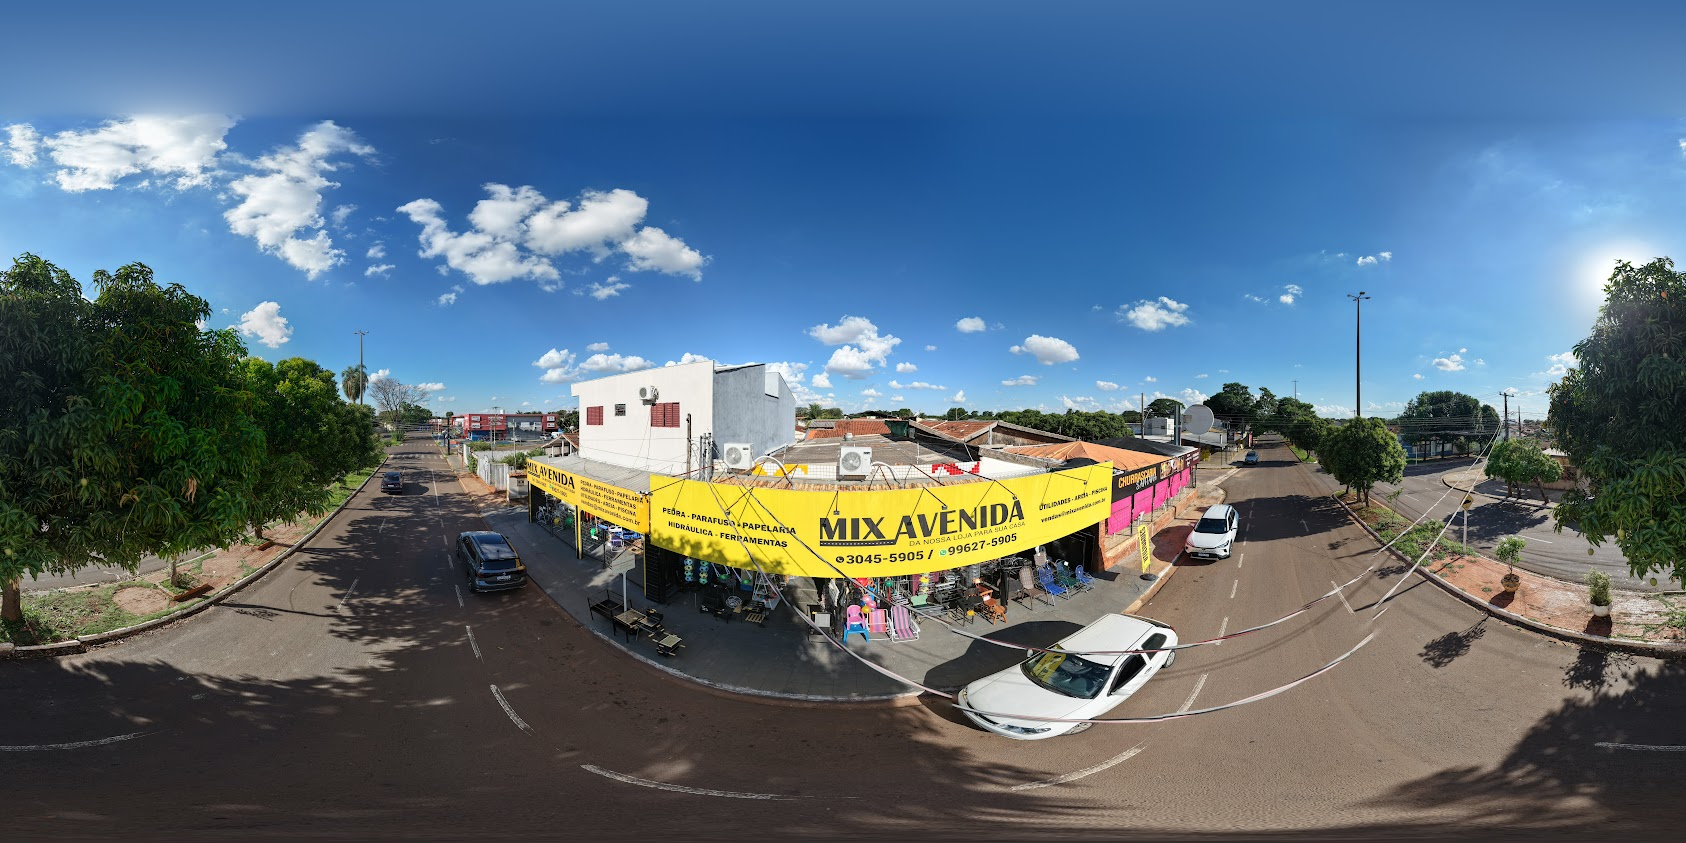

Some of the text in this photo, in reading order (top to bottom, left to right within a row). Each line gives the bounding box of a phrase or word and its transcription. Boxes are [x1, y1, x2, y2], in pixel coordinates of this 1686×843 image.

[540, 466, 575, 490] AVENIDA
[1039, 498, 1071, 510] UTILIDADES
[820, 500, 1025, 540] MIX AVENIDA
[668, 521, 713, 536] HIDRÁULICA
[720, 532, 788, 548] FERRAMENTAS
[923, 536, 952, 545] NOSSA
[953, 532, 973, 540] LOJA
[974, 528, 993, 537] PARA
[1009, 521, 1026, 530] CASA
[846, 550, 924, 564] 3045-5905
[948, 533, 1017, 555] 99627-5905
